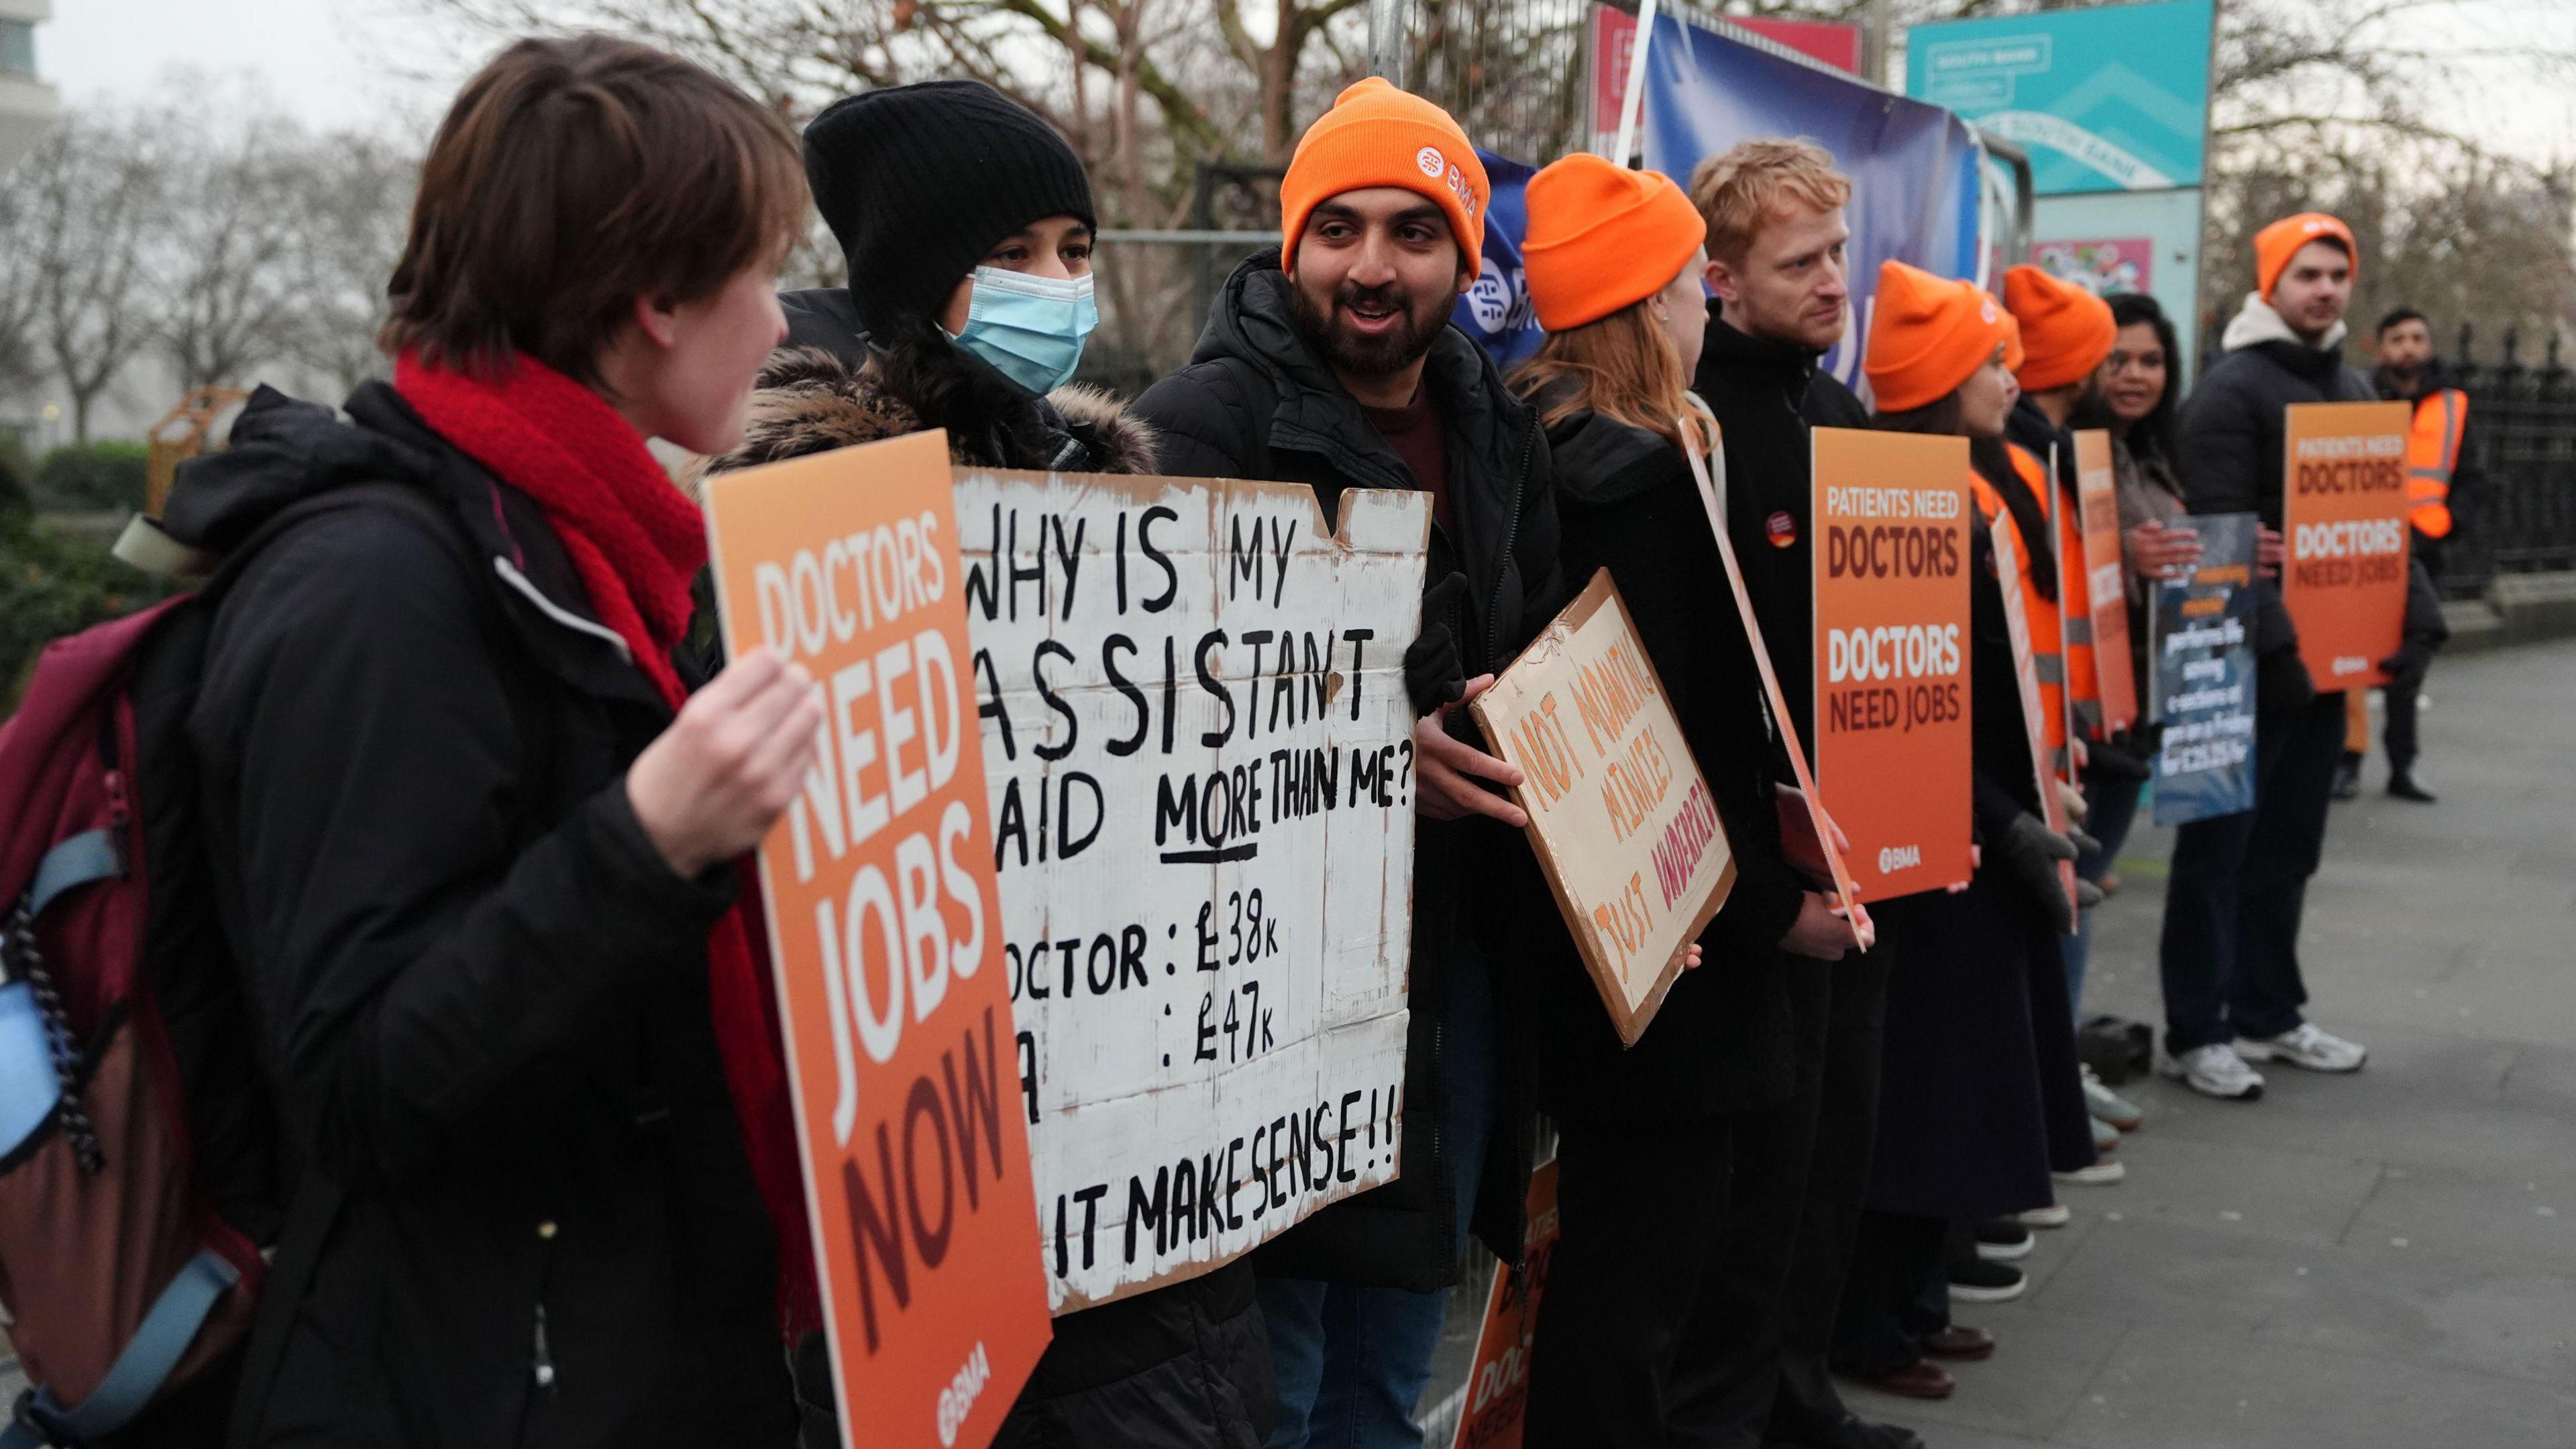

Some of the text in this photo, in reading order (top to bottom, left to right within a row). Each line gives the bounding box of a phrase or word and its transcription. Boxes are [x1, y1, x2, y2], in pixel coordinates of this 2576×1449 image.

[1447, 164, 1477, 219] BMA
[2298, 435, 2404, 458] PATIENTS NEED
[2298, 459, 2402, 495] DOCTORS
[1827, 486, 1960, 519] PATIENTS NEED
[2296, 518, 2402, 559] DOCTORS
[754, 510, 946, 661] DOCTORS
[966, 502, 1297, 622] WHY IS MY
[1828, 525, 1960, 579] DOCTORS
[972, 628, 1375, 762] ASSISTANT
[1828, 623, 1961, 683] DOCTORS
[1509, 690, 1585, 812] NOT
[1829, 683, 1960, 733] NEED JOBS
[789, 629, 961, 884] NEED
[996, 739, 1413, 872] AID MORE THAN ME?
[1594, 777, 1716, 984] JUST UNDERPAID
[814, 800, 985, 1149] JOBS
[1005, 923, 1148, 1004] OCTOR
[843, 1005, 1004, 1358] NOW
[1055, 1183, 1108, 1279] IT
